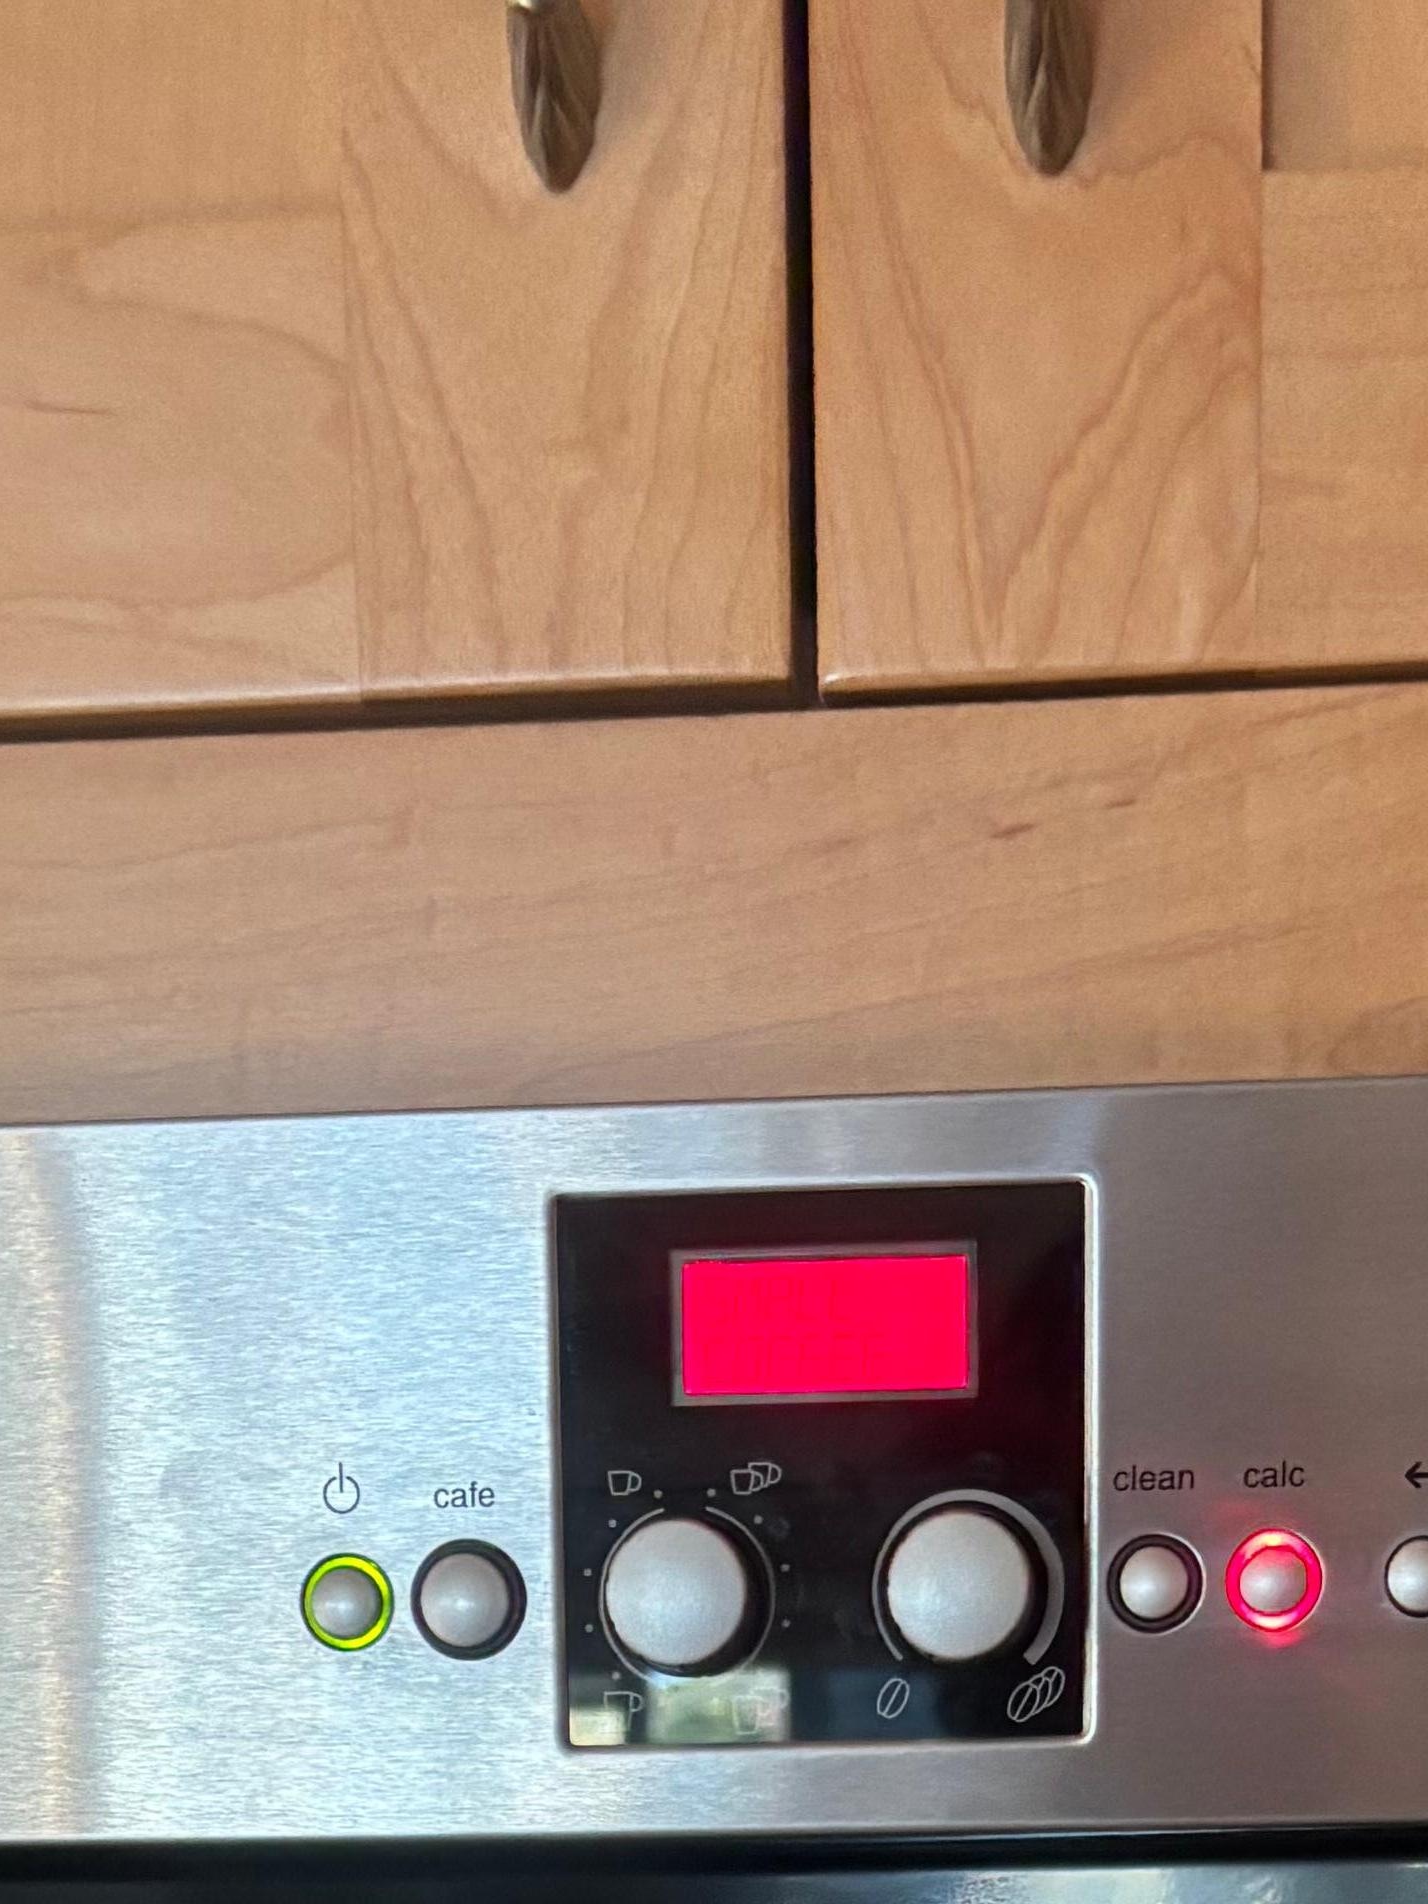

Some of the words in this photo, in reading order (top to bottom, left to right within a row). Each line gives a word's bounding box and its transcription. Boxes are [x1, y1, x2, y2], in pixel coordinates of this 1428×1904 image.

[1113, 1464, 1195, 1492] clean
[1243, 1459, 1305, 1489] calc
[434, 1480, 495, 1509] cafe
